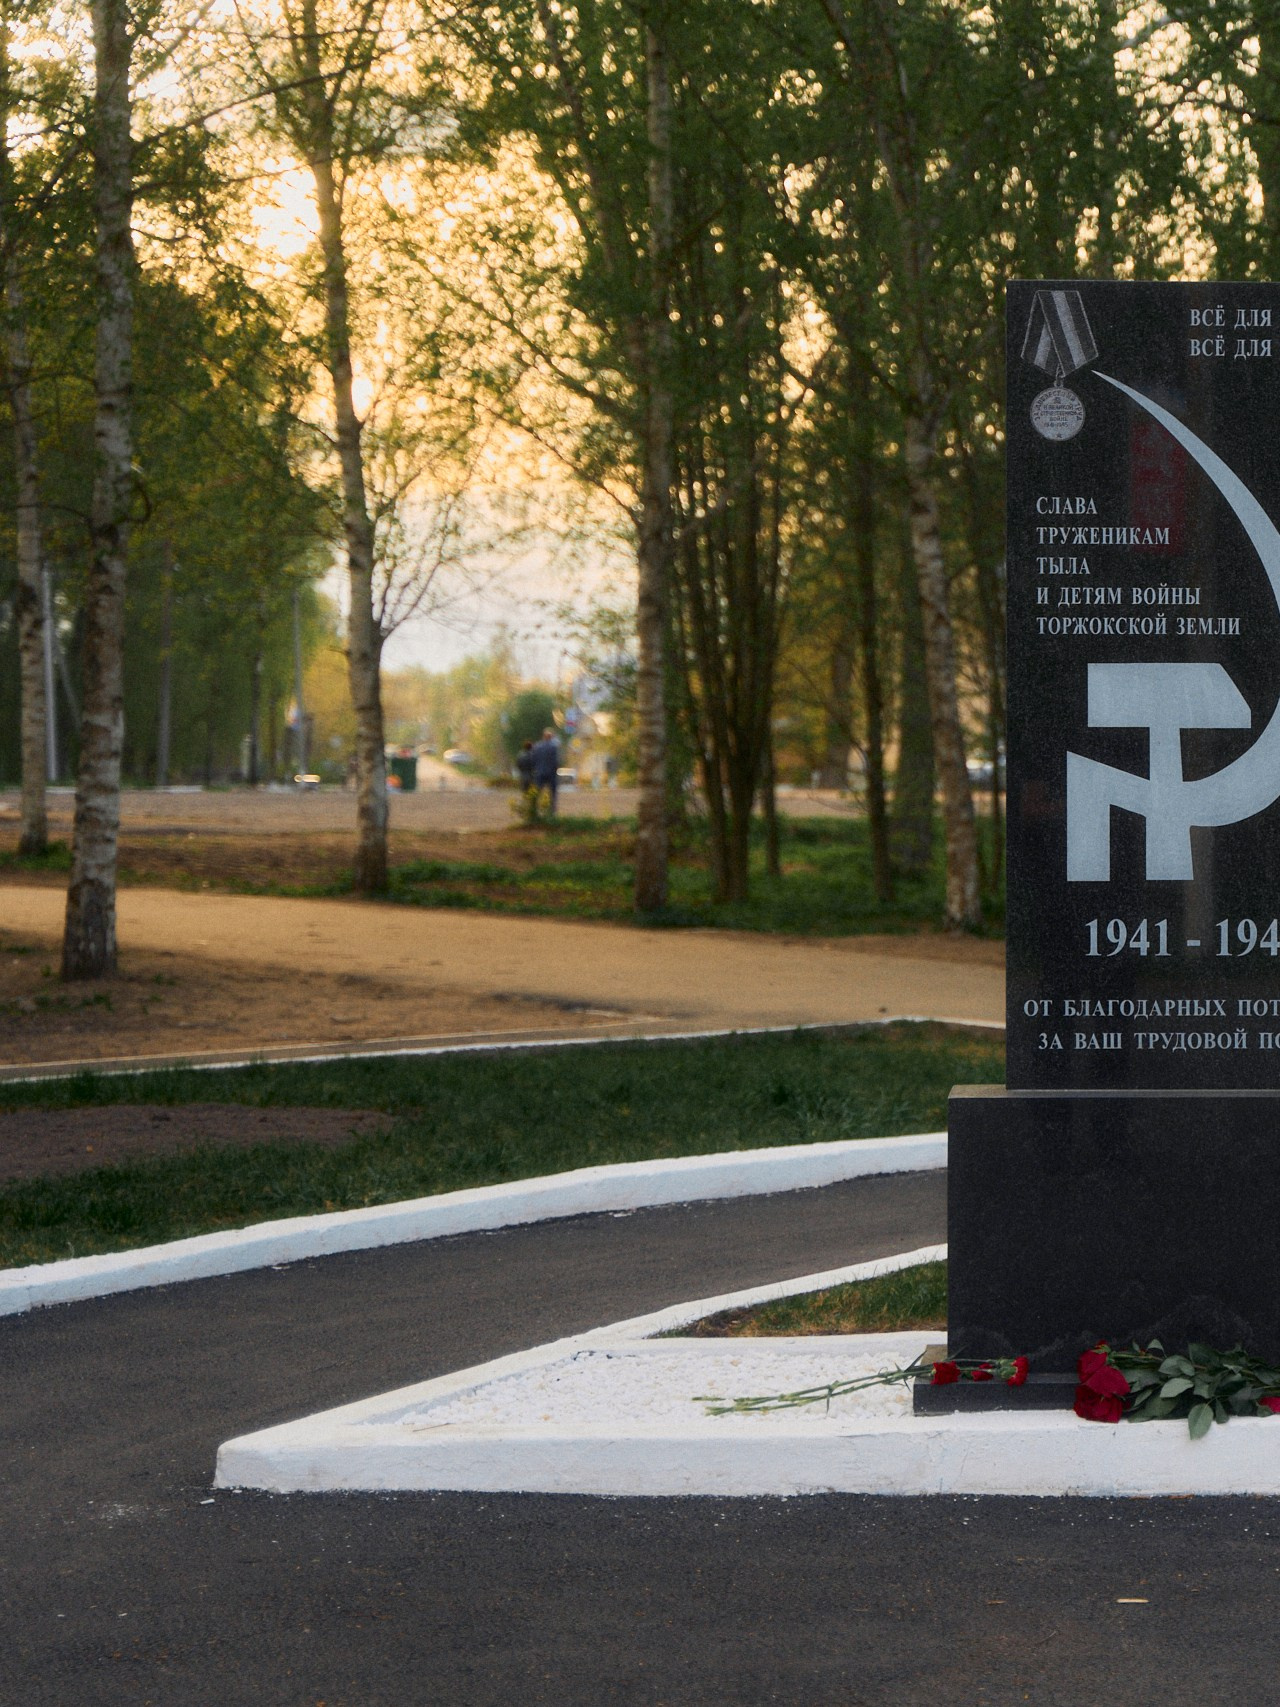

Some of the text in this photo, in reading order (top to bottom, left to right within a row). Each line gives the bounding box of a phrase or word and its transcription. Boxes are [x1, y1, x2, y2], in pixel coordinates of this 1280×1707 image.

[1190, 304, 1226, 327] ВСЁ
[1233, 308, 1272, 330] ДЛЯ
[1190, 334, 1226, 357] ВСЁ
[1233, 339, 1272, 361] ДЛЯ
[1036, 496, 1098, 515] СЛАВА
[1036, 526, 1170, 545] ТРУЖЕНИКАМ
[1036, 556, 1091, 575] ТЫЛА
[1037, 582, 1201, 608] И ДЕТЯМ ВОЙНЫ
[1036, 612, 1241, 635] ТОРЖОКСКОЙ ЗЕМЛИ
[1085, 918, 1172, 957] 1941
[1023, 999, 1053, 1017] ОТ
[1064, 999, 1227, 1020] БЛАГОДАРНЫХ
[1038, 1032, 1063, 1050] ЗА
[1074, 1032, 1122, 1050] ВАШ
[1133, 1027, 1248, 1052] ТРУДОВОЙ
